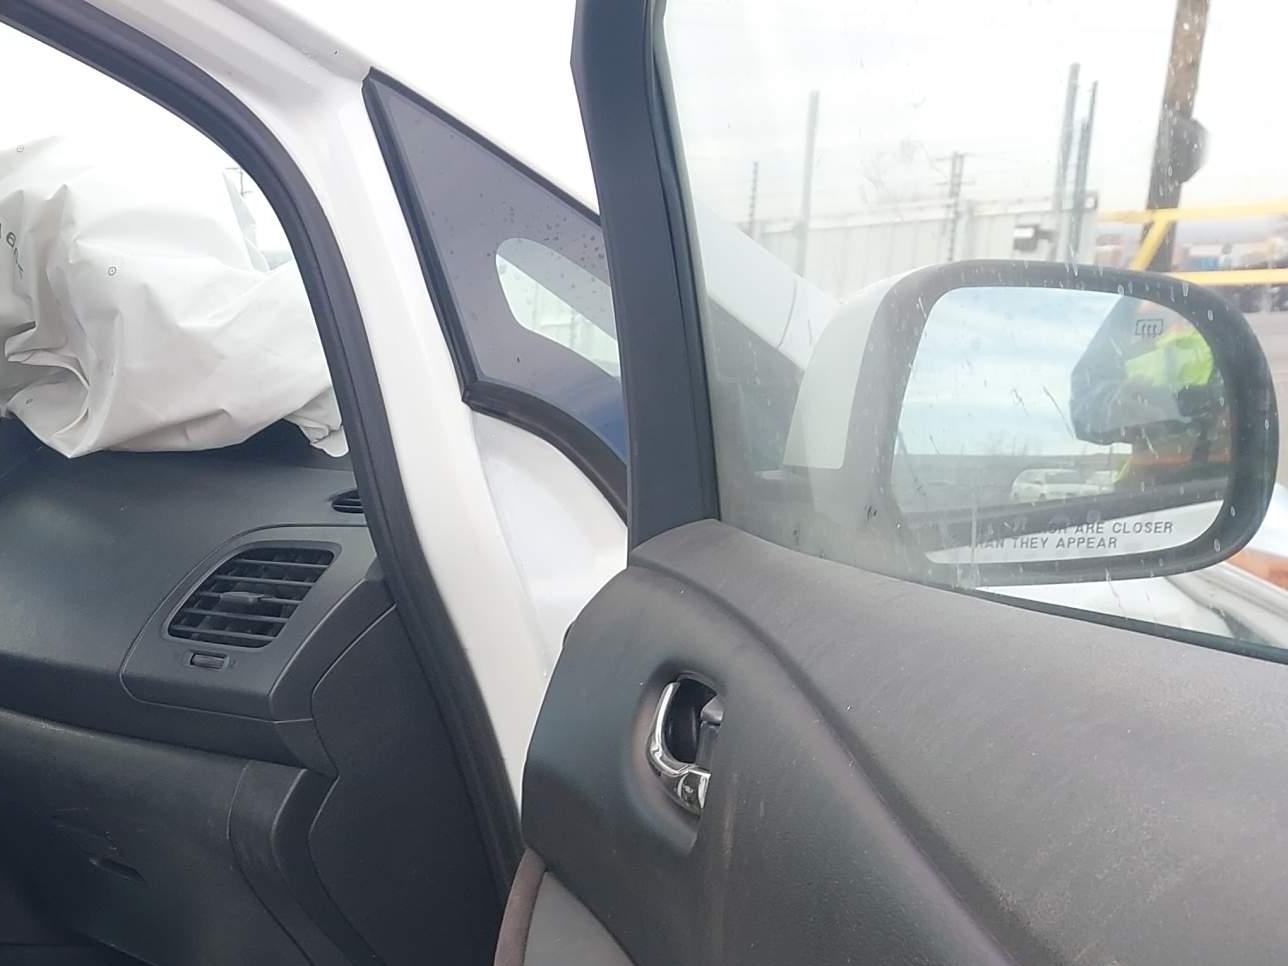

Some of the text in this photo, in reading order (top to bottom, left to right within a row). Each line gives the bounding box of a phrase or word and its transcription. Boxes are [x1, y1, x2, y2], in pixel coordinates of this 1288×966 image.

[1074, 521, 1104, 534] ARE
[1112, 521, 1173, 534] CLOSER
[1056, 536, 1117, 549] APPEAR
